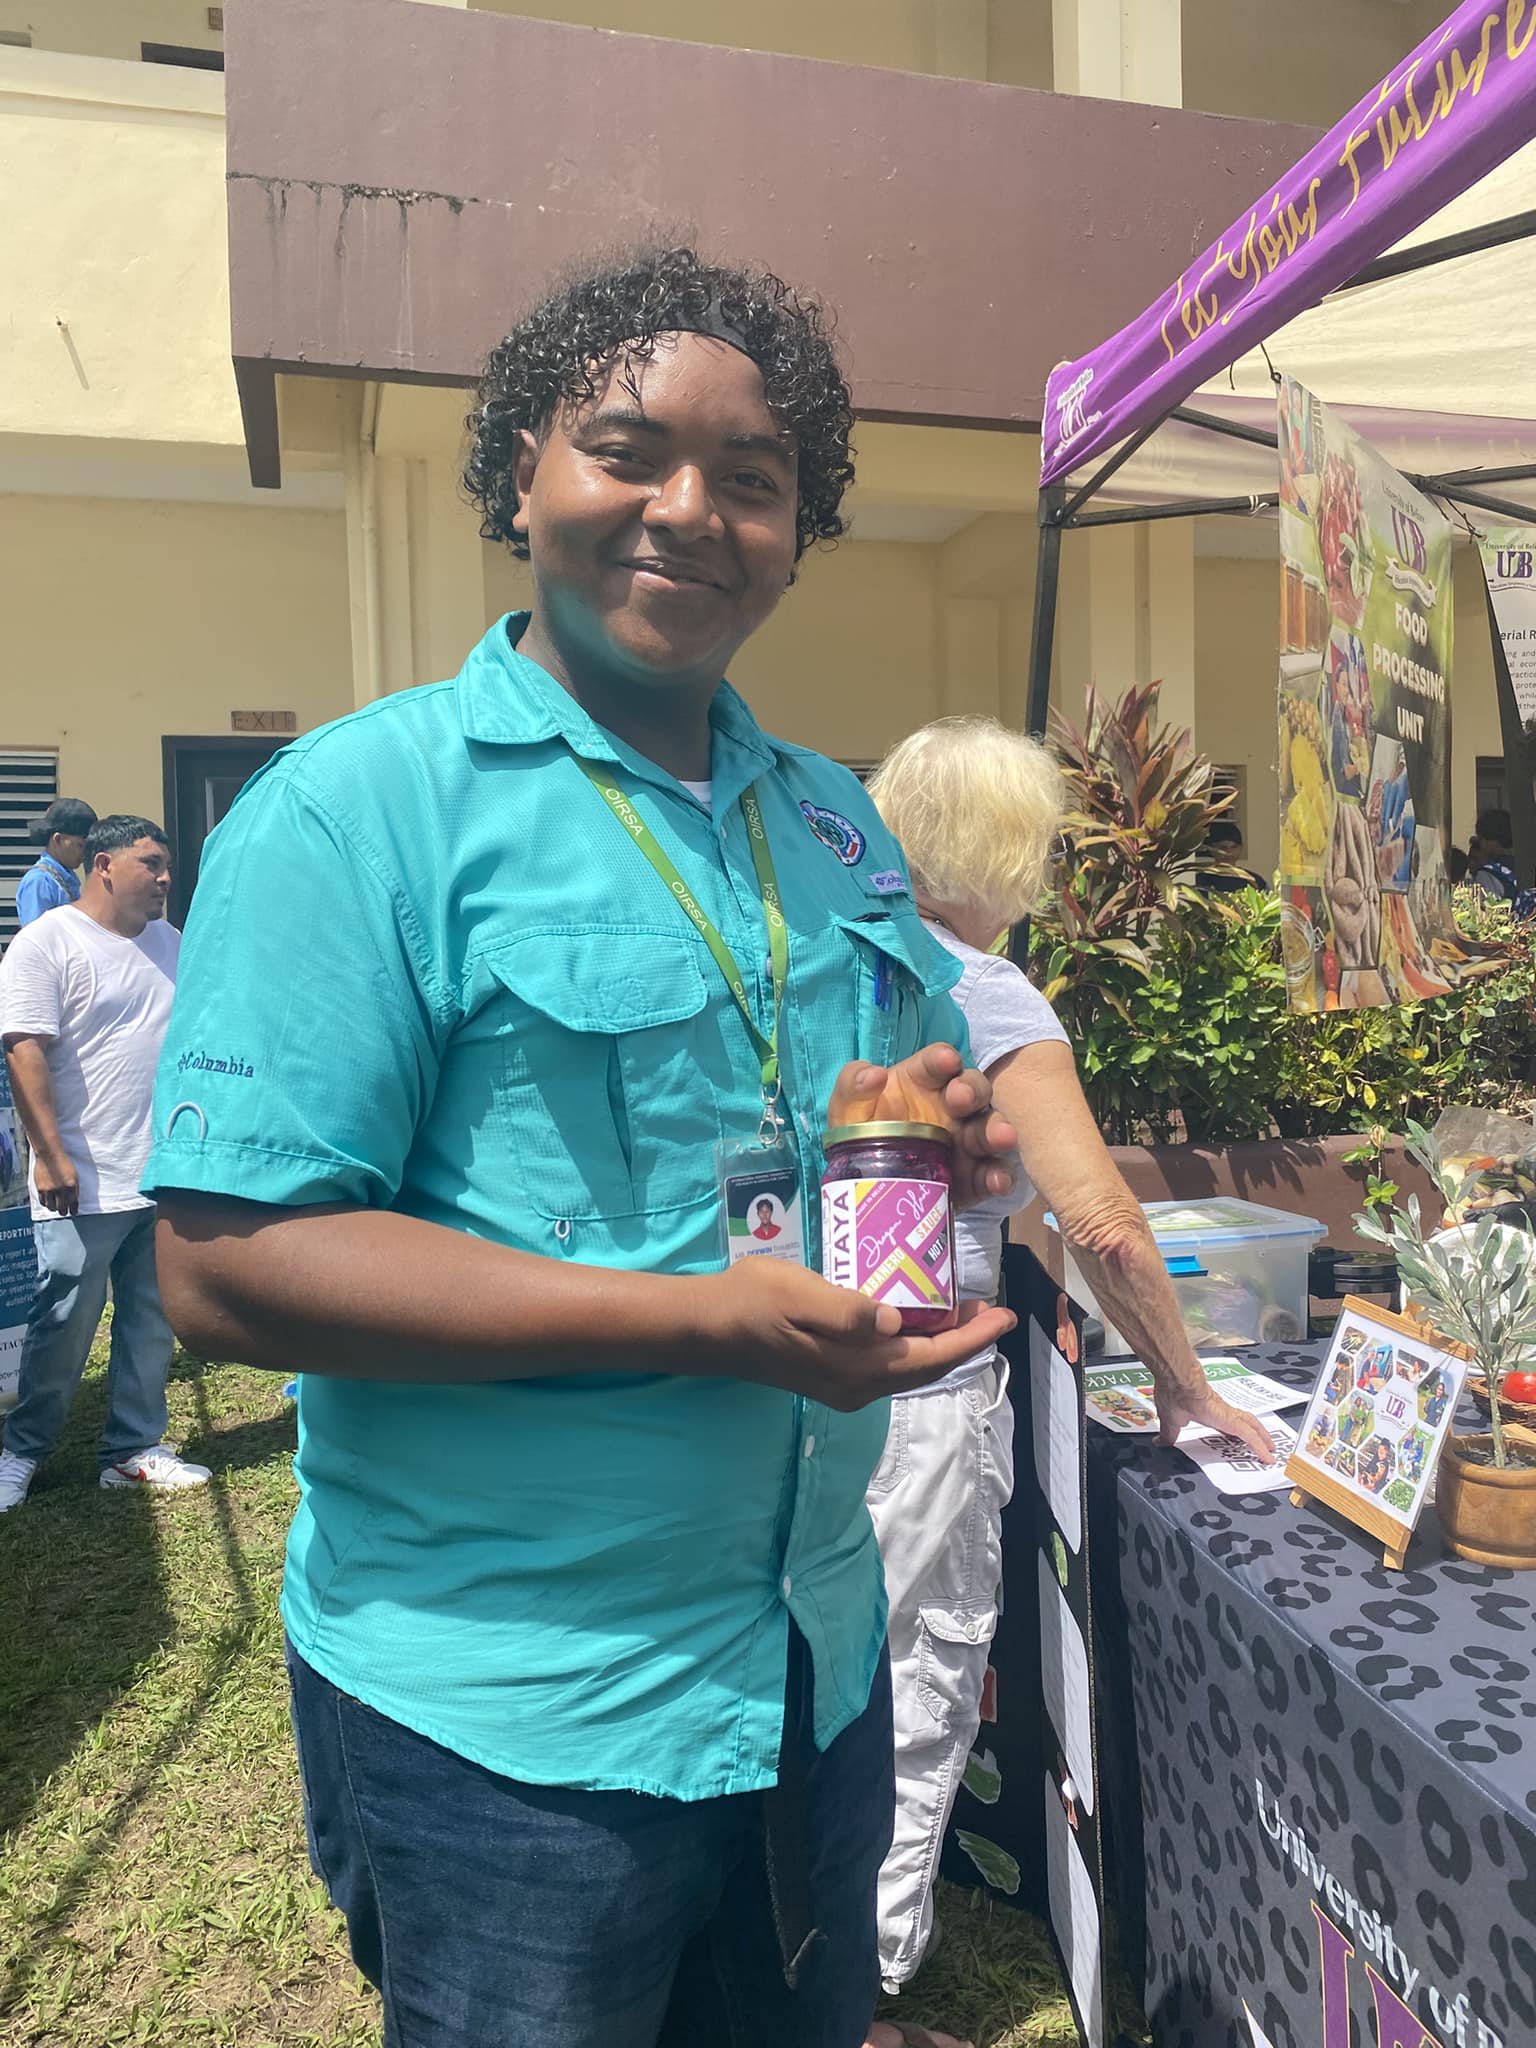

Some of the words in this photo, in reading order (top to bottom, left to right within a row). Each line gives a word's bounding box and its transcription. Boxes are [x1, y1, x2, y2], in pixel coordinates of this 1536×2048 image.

[1391, 504, 1427, 575] UB
[1497, 551, 1533, 578] UB
[1395, 601, 1428, 647] FOOD
[1499, 629, 1526, 640] erial
[1373, 642, 1445, 705] PROCESSING
[232, 711, 292, 731] EXIT
[1397, 705, 1425, 744] UNIT
[605, 788, 644, 837] OIRSA
[749, 798, 765, 840] OIRSA
[672, 881, 708, 931] OIRSA
[764, 882, 783, 928] OIRSA
[185, 1050, 255, 1078] Columbia
[0, 1226, 35, 1241] EPORTING
[834, 1190, 850, 1287] ITAYA
[915, 1206, 942, 1239] SAUCE
[861, 1247, 906, 1297] ABANERO
[927, 1238, 943, 1262] HOT
[1255, 1777, 1420, 2003] University
